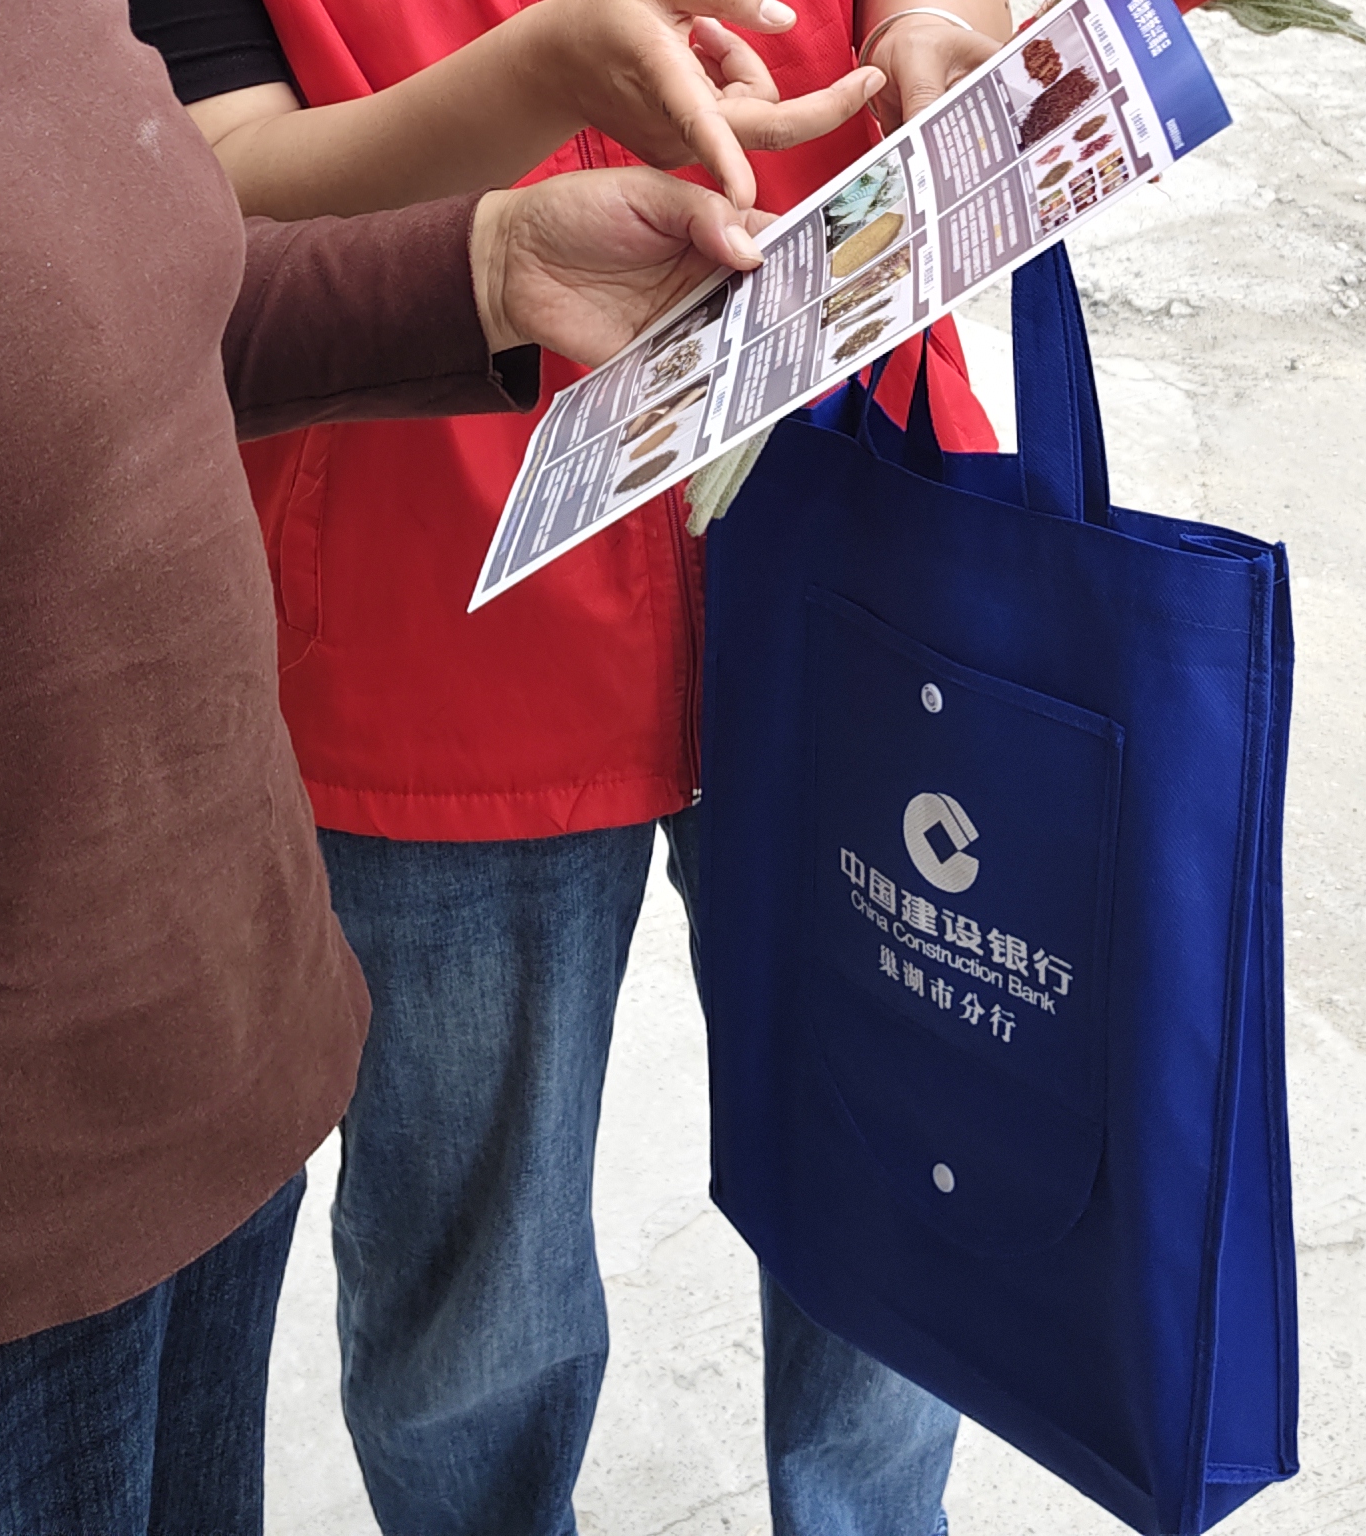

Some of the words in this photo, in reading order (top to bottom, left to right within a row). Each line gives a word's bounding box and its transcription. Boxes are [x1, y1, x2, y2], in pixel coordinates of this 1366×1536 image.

[840, 847, 1073, 995] 中国建设银行
[851, 890, 888, 932] China
[892, 922, 1003, 988] Construction
[1008, 974, 1056, 1014] Bank
[879, 944, 1016, 1042] 巢湖市分行
